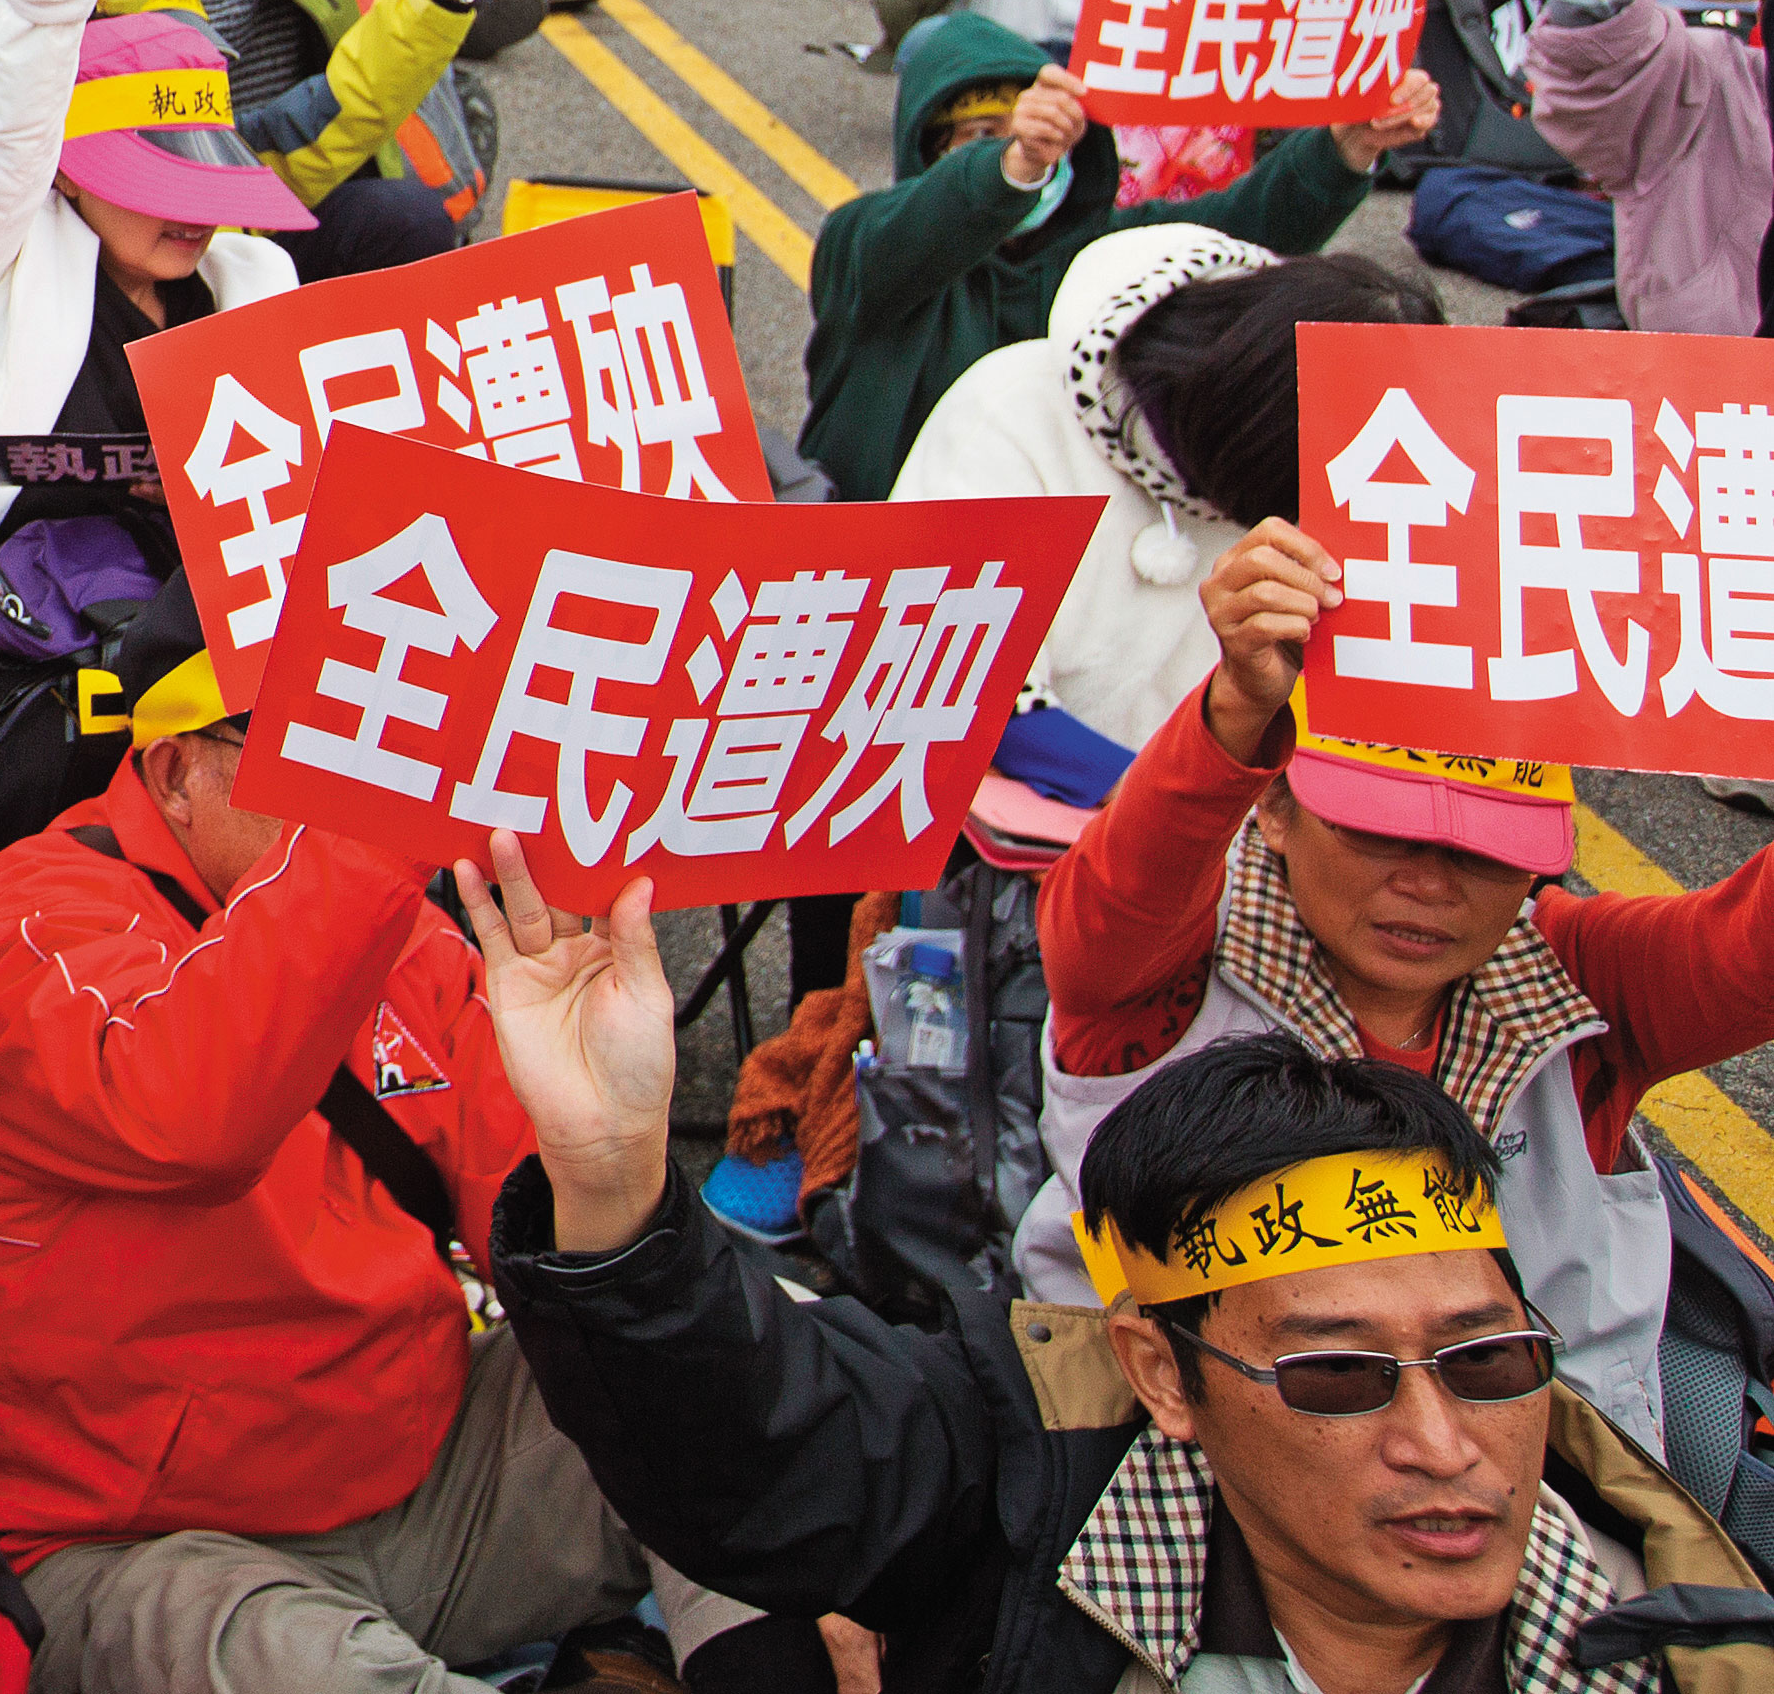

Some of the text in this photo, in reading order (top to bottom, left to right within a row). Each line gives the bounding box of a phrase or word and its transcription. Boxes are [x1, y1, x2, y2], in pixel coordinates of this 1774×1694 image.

[153, 80, 232, 119] 執政
[282, 513, 1022, 867] 全民遭殃
[1173, 1166, 1481, 1278] 執政無能
